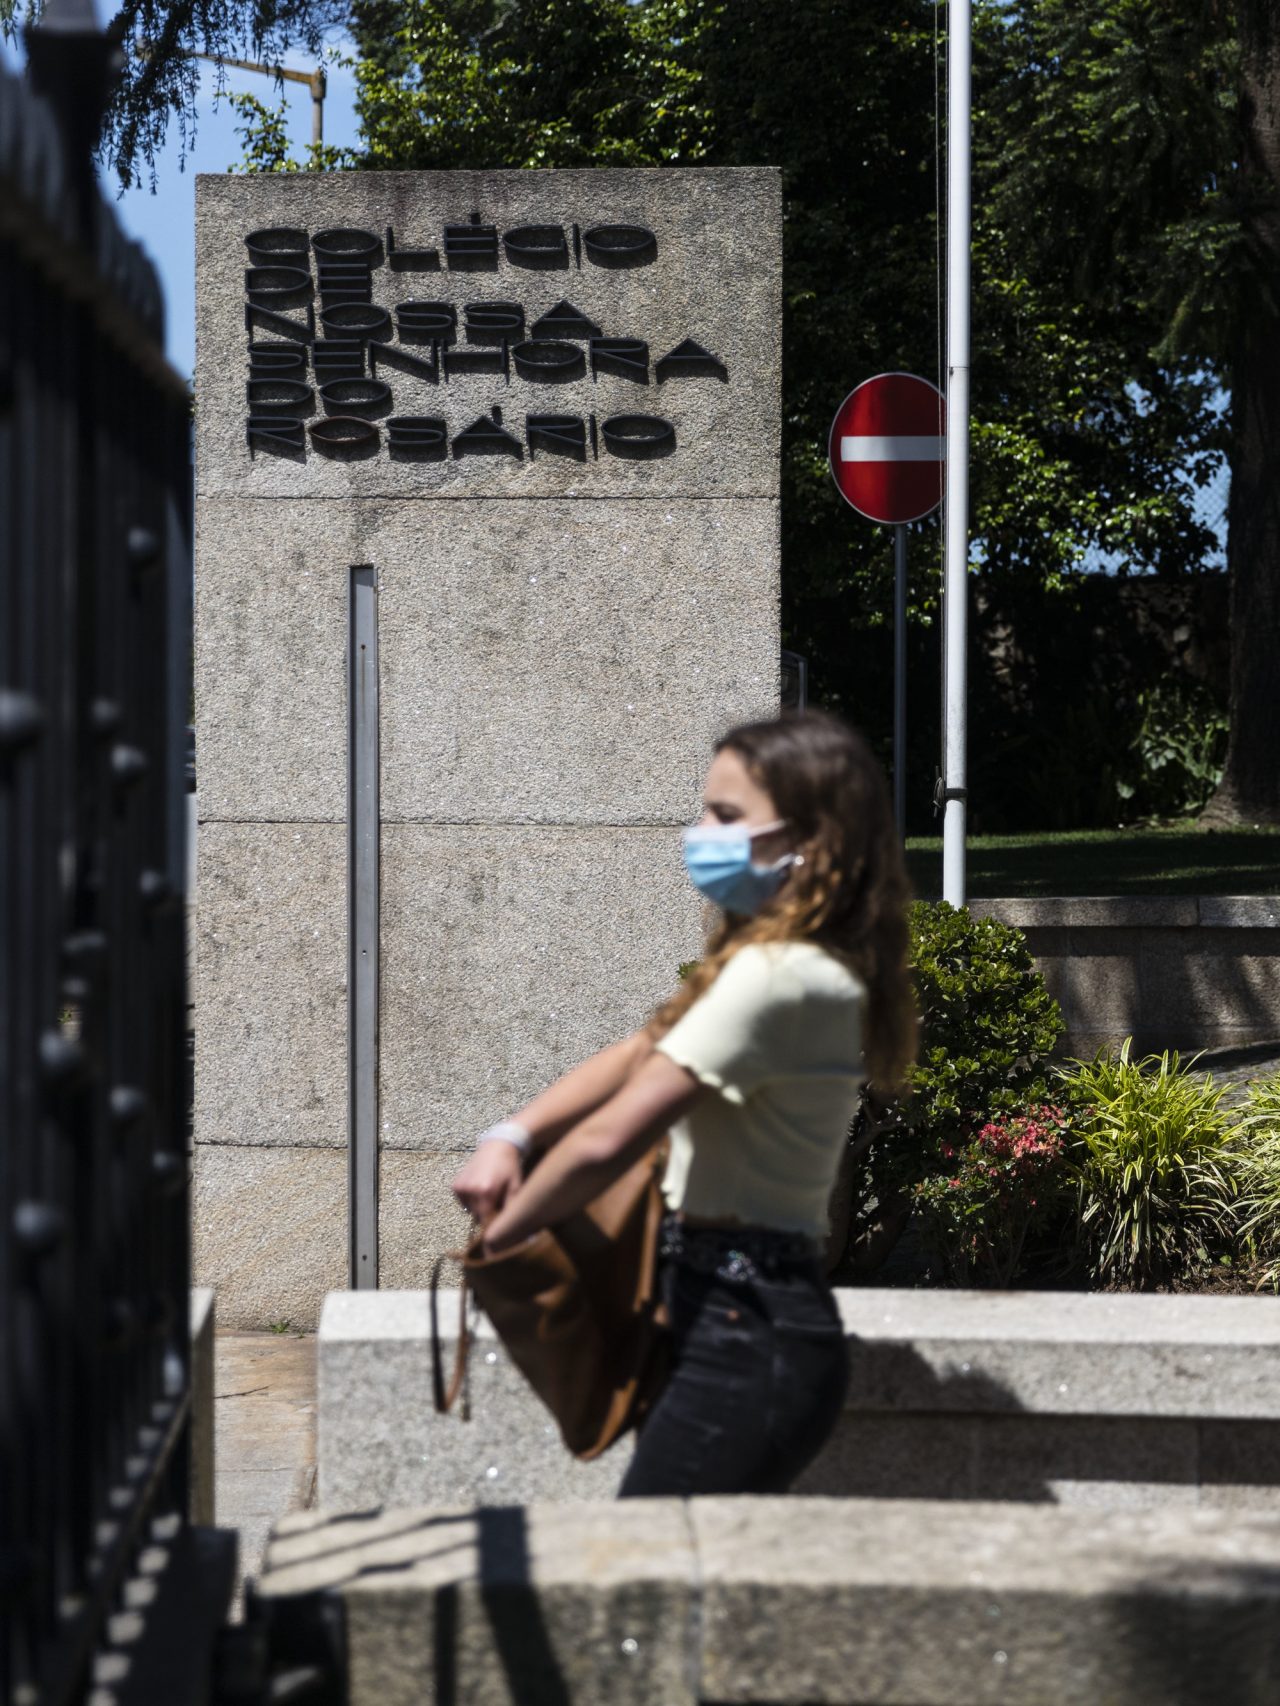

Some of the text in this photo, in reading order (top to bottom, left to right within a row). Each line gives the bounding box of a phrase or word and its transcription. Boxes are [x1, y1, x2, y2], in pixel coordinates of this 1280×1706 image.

[244, 212, 657, 263] COLÉGIO
[245, 263, 369, 299] DE
[245, 300, 600, 335] NOSSA
[246, 337, 729, 376] SENHORA
[246, 377, 393, 410] DO
[246, 405, 676, 453] ROSÁRIO
